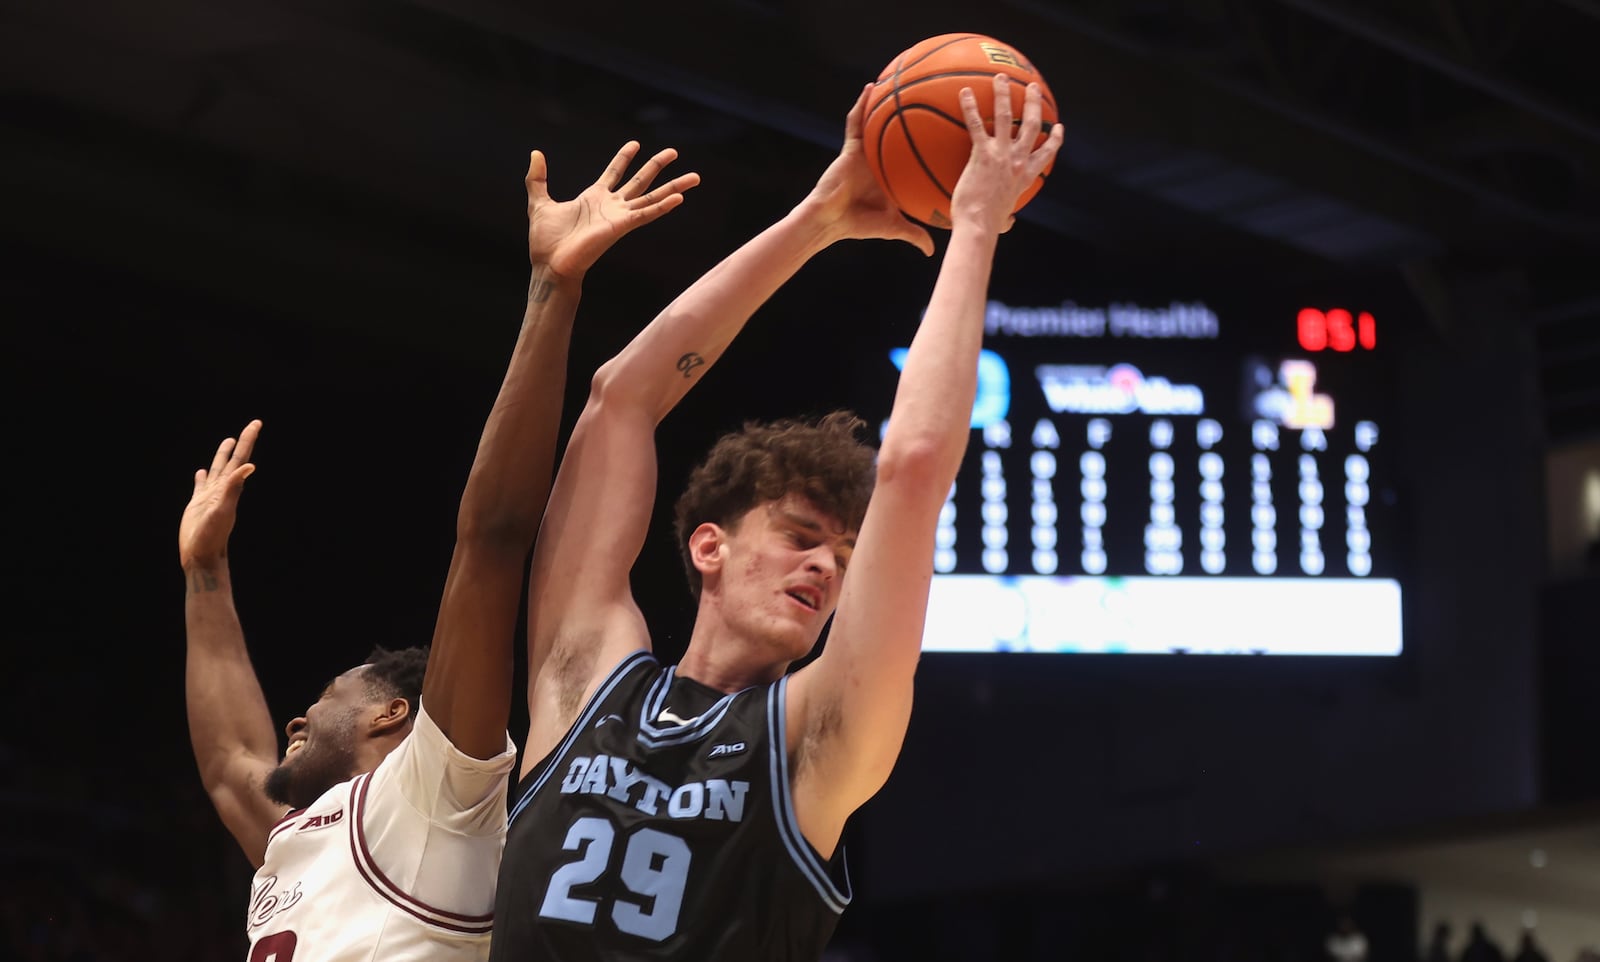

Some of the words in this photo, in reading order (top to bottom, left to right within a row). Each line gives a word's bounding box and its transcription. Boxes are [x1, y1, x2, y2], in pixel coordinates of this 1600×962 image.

[1108, 303, 1219, 337] Health
[708, 742, 746, 758] A10
[560, 754, 749, 822] DAYTON
[298, 809, 344, 831] A10
[539, 817, 692, 942] 29
